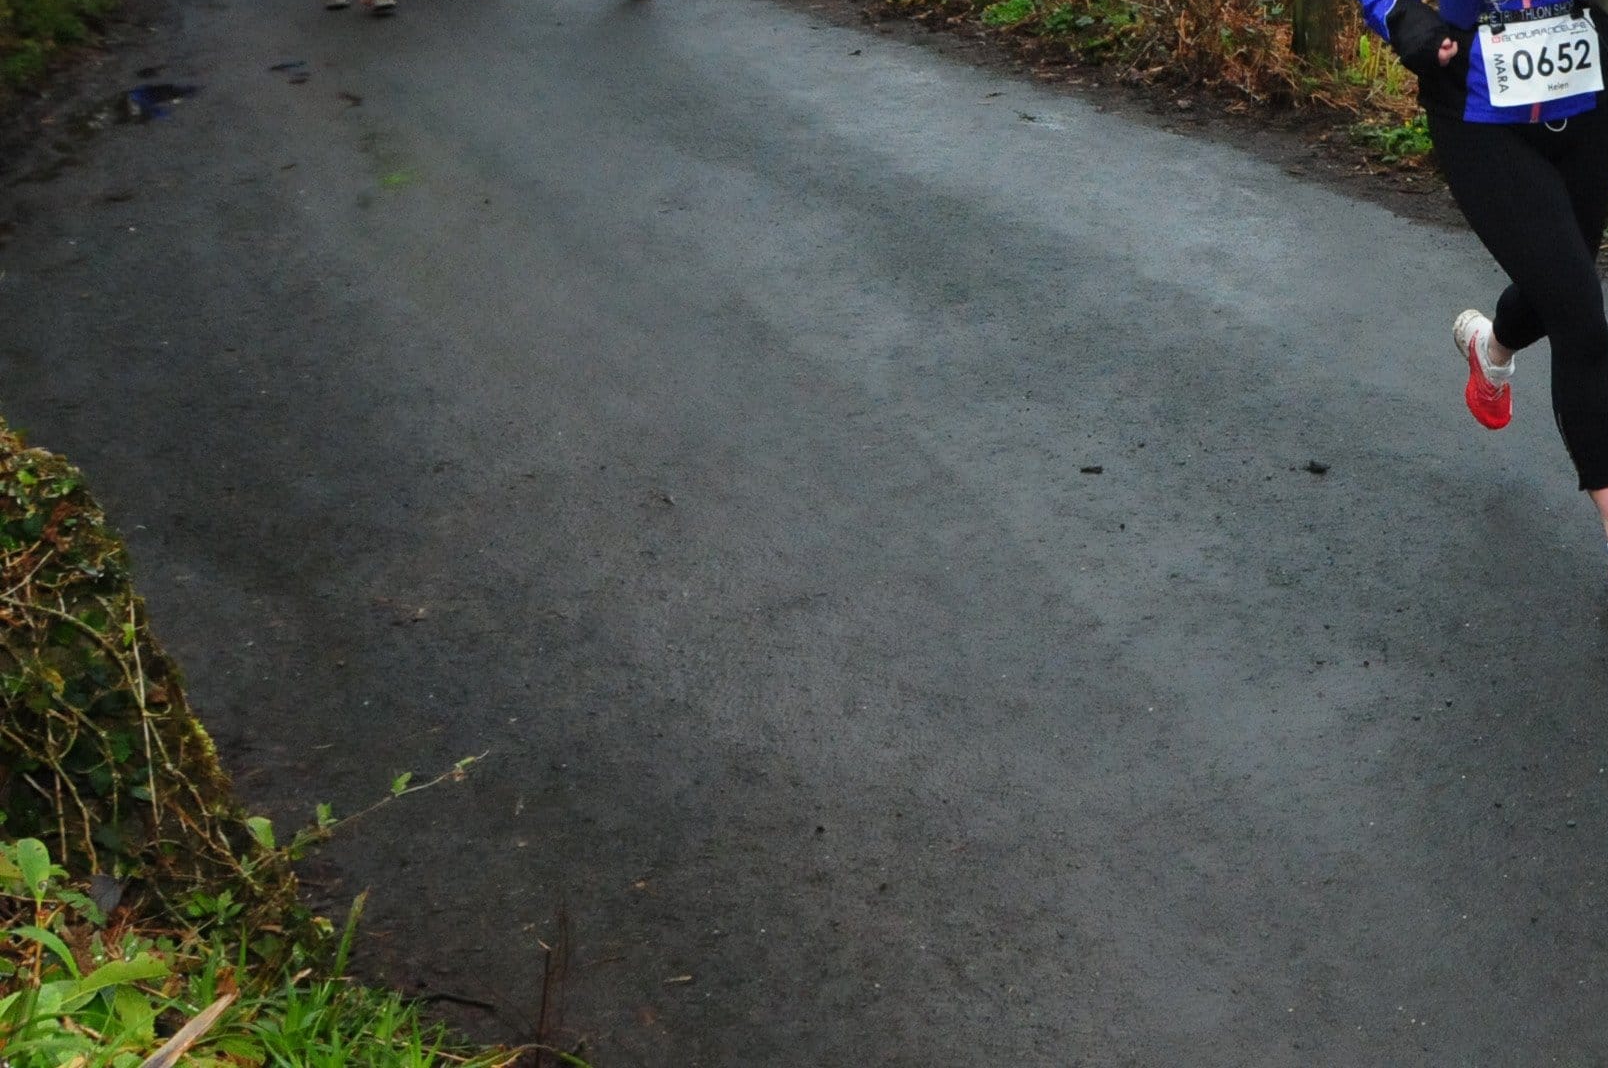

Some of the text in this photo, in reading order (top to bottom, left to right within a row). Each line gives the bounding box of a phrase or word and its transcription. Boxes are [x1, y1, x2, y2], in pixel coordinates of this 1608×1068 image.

[1493, 53, 1509, 94] MARA
[1512, 39, 1592, 81] 0652
[1547, 81, 1570, 92] Helen
